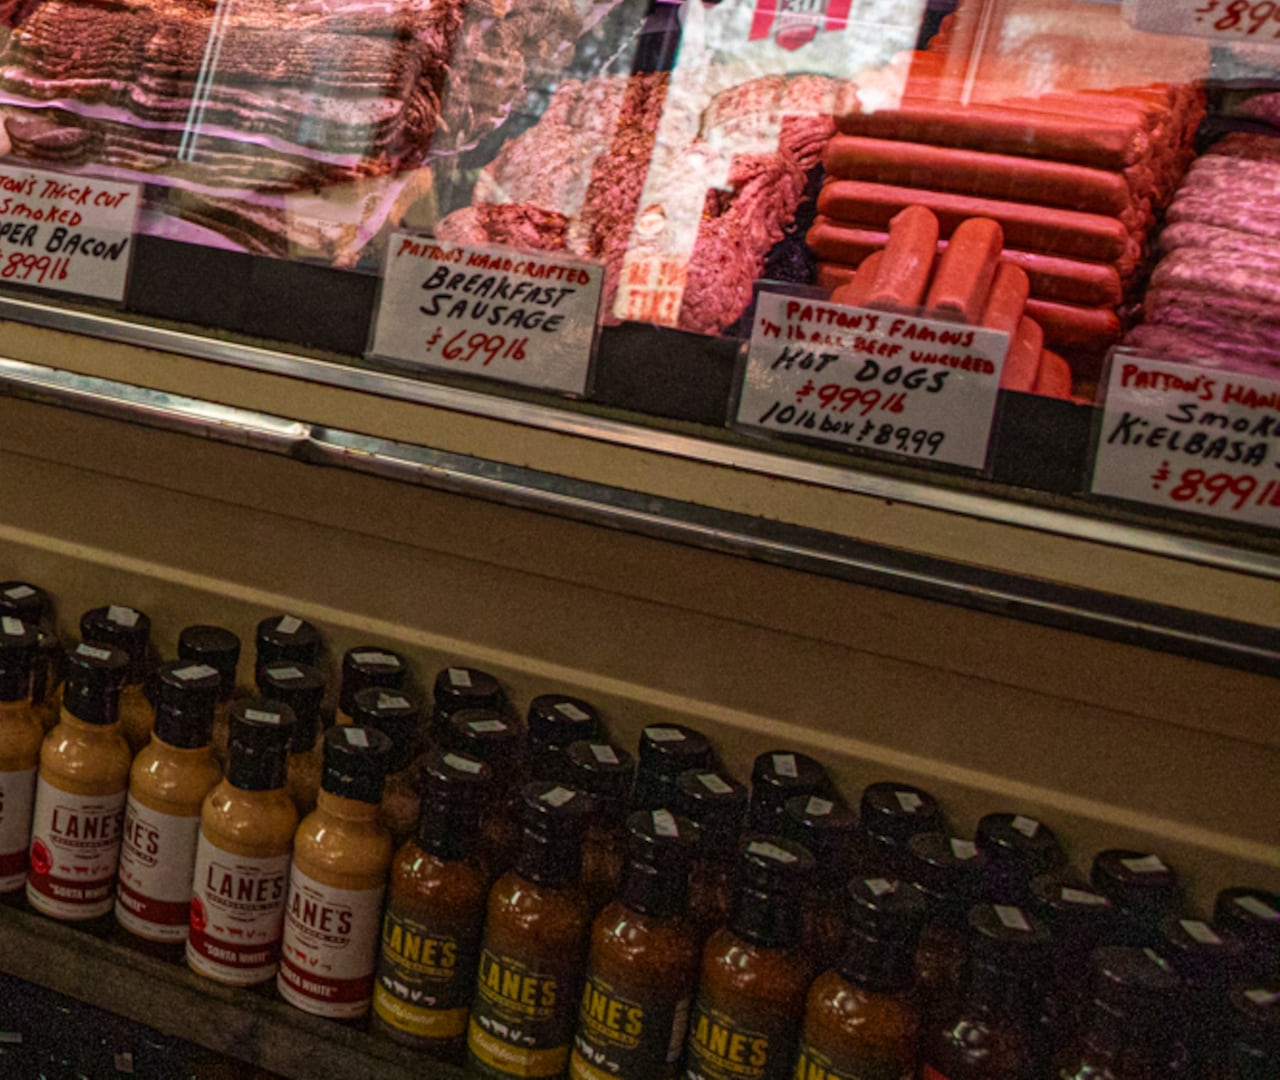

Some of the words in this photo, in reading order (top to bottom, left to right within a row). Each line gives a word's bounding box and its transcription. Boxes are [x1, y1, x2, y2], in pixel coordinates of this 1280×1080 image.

[93, 190, 131, 209] CUT
[45, 226, 129, 261] BACON
[397, 238, 465, 264] PATTON'S
[466, 252, 591, 286] HANDCRAFTED
[421, 265, 576, 309] BREAKFAST
[419, 293, 566, 334] SAUSAGE
[786, 300, 880, 333] PATTON'S
[888, 319, 976, 348] FAMOUS
[425, 325, 530, 367] $6.99lb
[853, 335, 903, 358] BEEF
[910, 349, 995, 376] UNCURED
[771, 345, 839, 372] HOT
[854, 358, 951, 394] DOGS
[1120, 364, 1217, 402] PATTON'S
[856, 418, 946, 457] $89.99
[51, 808, 124, 839] LANE'S
[206, 865, 284, 902] LANE'S
[382, 920, 458, 969] LANE'S
[480, 953, 557, 1007] LANE'S
